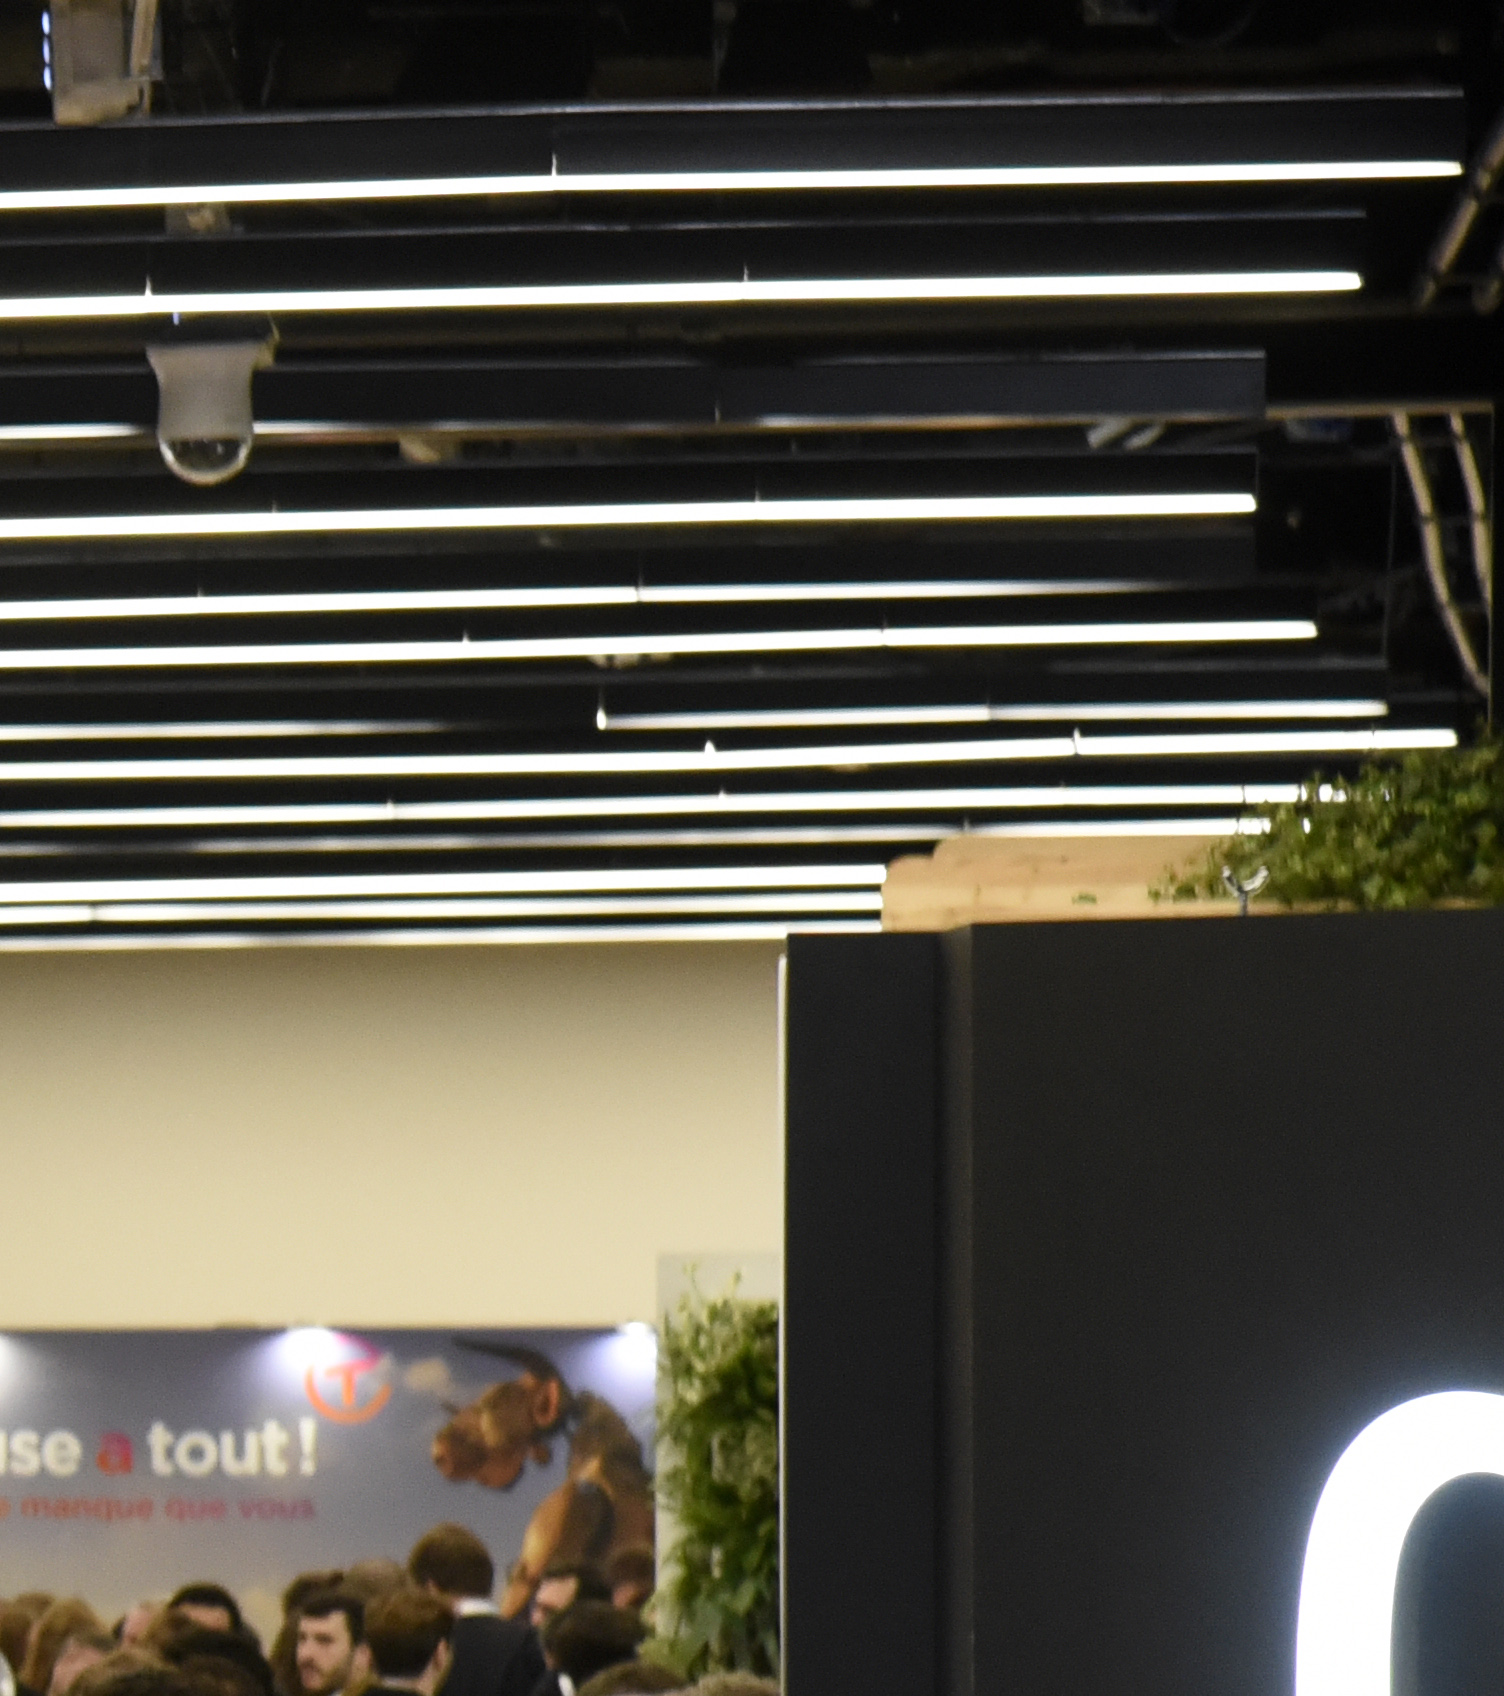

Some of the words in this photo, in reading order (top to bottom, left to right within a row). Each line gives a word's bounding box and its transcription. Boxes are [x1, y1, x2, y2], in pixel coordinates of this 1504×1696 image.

[95, 1431, 135, 1476] a
[20, 1496, 154, 1525] manque
[164, 1496, 227, 1524] que
[237, 1496, 316, 1520] vous
